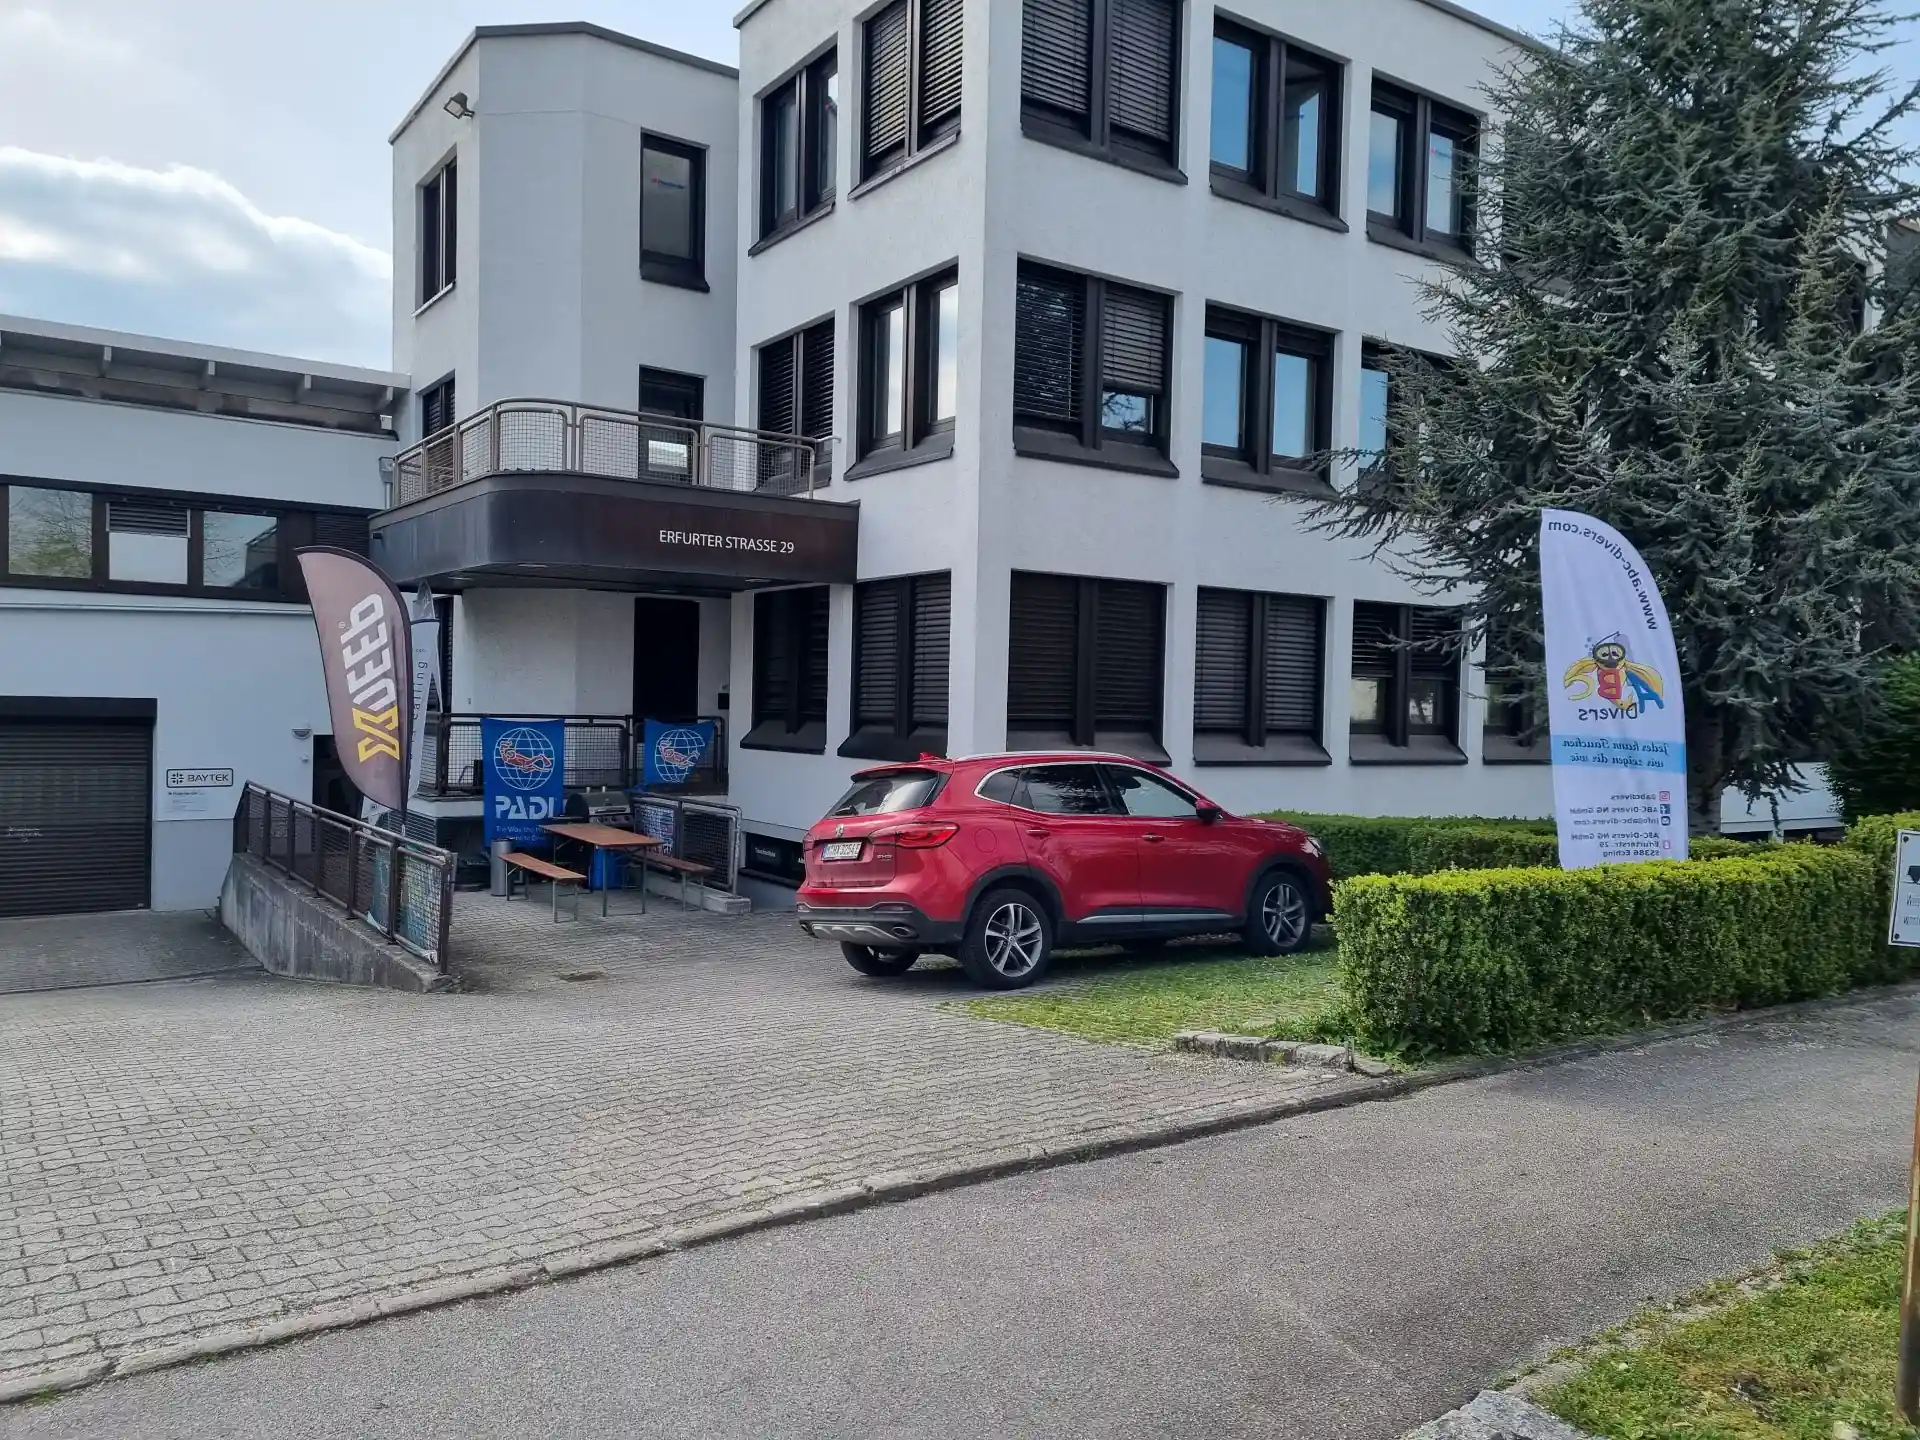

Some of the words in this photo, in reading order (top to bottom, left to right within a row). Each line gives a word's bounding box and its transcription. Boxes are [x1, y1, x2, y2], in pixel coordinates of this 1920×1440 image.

[659, 529, 722, 548] ERFURTER
[725, 536, 777, 552] STRASSE
[779, 541, 795, 554] 29
[187, 773, 229, 782] BAYTEK
[495, 795, 555, 820] PADI
